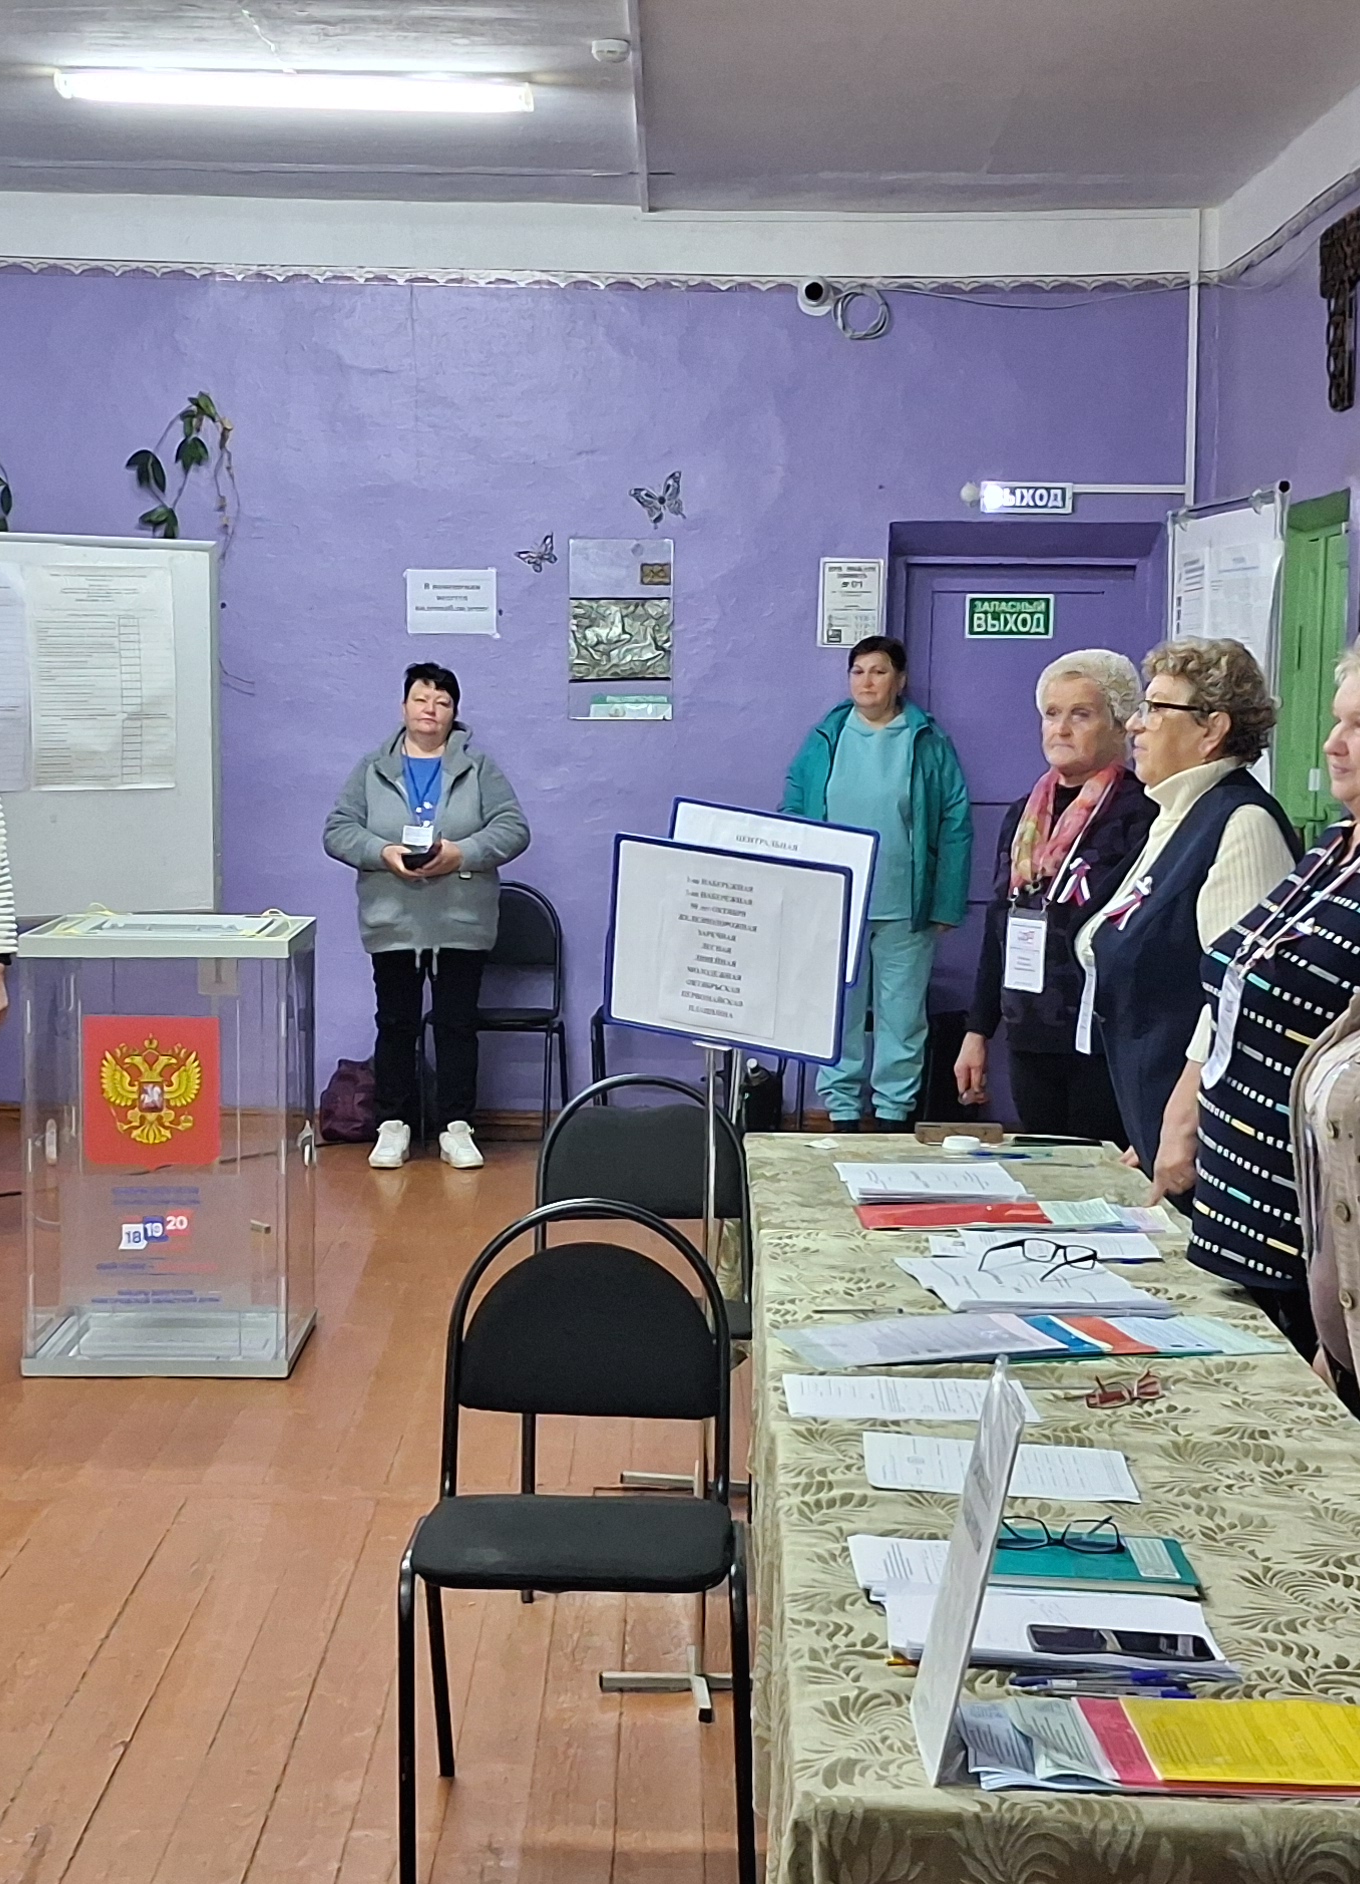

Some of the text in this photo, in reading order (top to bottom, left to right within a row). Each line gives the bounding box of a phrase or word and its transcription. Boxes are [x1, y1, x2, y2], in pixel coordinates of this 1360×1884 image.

[990, 487, 1064, 509] ЫХОД
[973, 600, 1045, 612] ЗАПАСНЫЙ
[973, 613, 1045, 633] ВЫХОД
[735, 834, 799, 851] ЦЕНТРАЛЬНАЯ
[125, 1215, 188, 1244] 18 19 20
